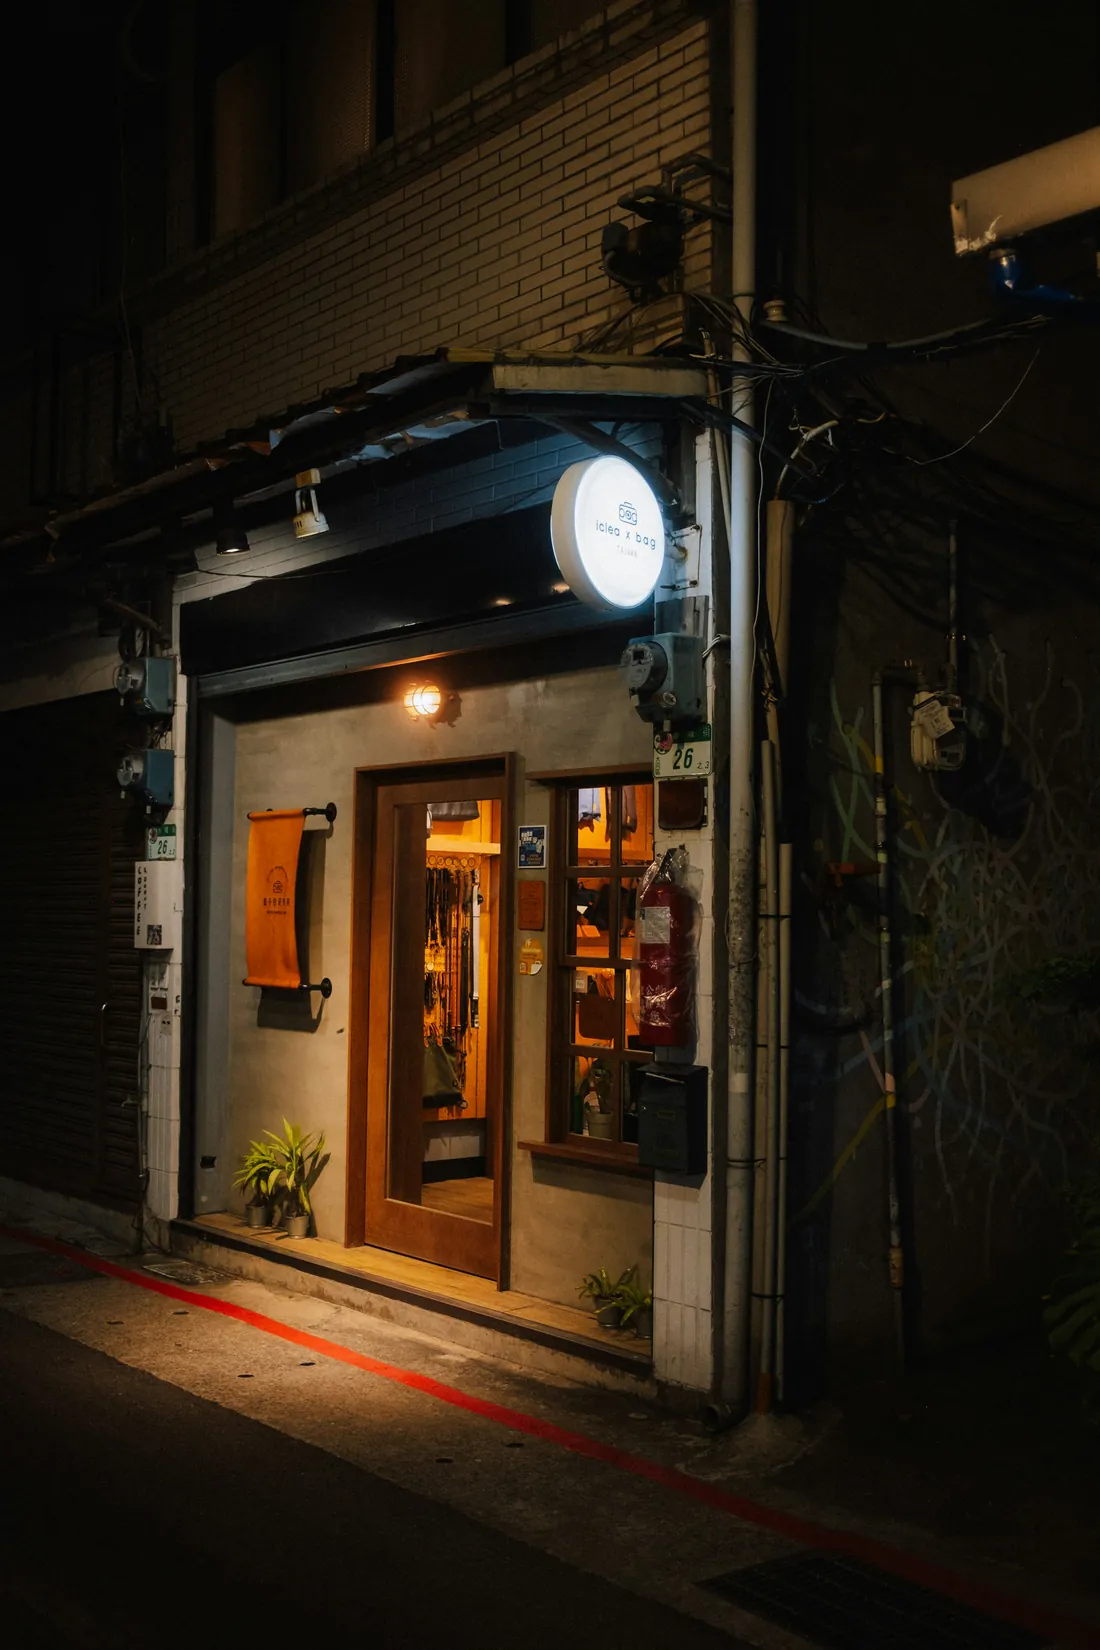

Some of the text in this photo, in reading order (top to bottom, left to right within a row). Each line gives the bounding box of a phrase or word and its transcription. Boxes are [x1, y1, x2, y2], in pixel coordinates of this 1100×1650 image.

[596, 520, 620, 536] iclea
[635, 532, 656, 550] bag
[673, 748, 693, 769] 26
[157, 839, 168, 855] 26
